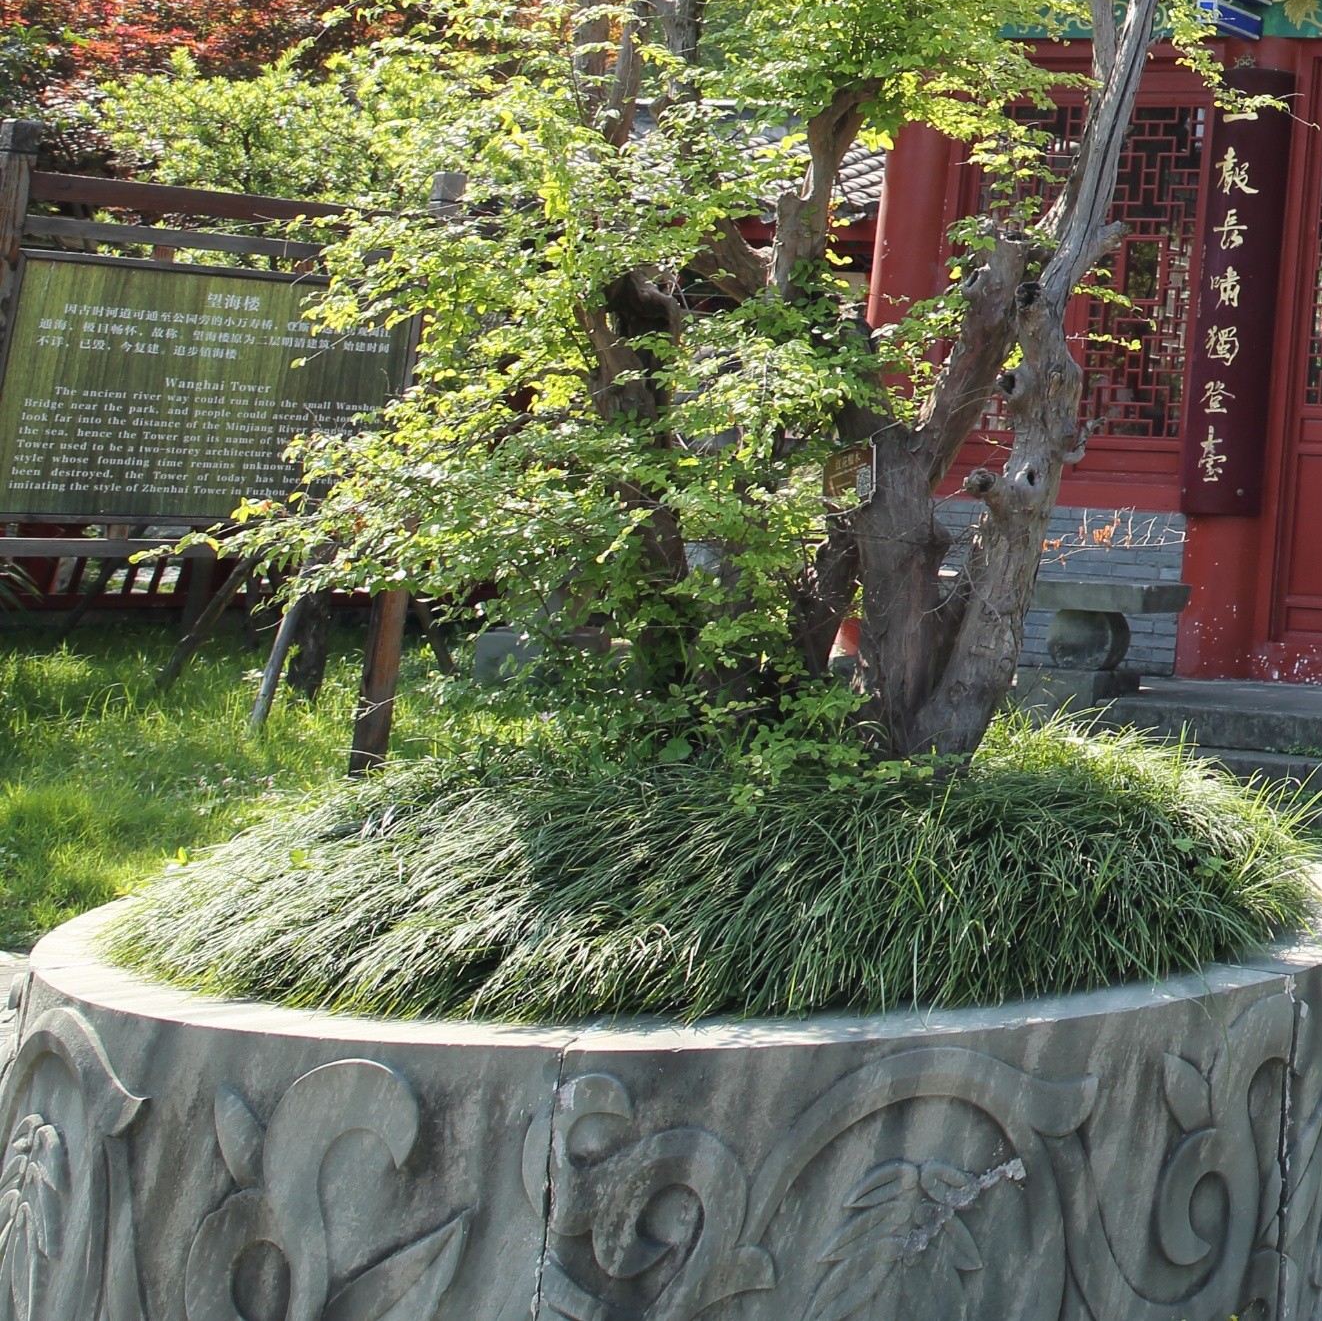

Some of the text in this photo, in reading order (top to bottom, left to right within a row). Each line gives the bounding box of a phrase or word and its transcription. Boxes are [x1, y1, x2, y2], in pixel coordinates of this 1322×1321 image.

[207, 292, 261, 312] 望海楼
[165, 377, 271, 393] Wanghai Tower
[55, 386, 77, 396] The
[82, 389, 127, 398] ancient
[133, 391, 162, 400] river
[167, 394, 189, 404] way
[194, 396, 225, 405] could
[230, 398, 249, 406] run
[254, 398, 276, 407] into
[280, 399, 298, 408] the
[303, 401, 331, 410] small
[24, 398, 64, 410] Bridge
[104, 403, 123, 412] the
[168, 407, 189, 416] and
[194, 409, 231, 418] people
[237, 411, 267, 419] could
[272, 413, 309, 421] ascend
[21, 412, 49, 421] look
[54, 413, 72, 423] far
[78, 415, 102, 424] into
[107, 417, 127, 426] the
[132, 418, 181, 428] distance
[186, 421, 198, 429] of
[202, 421, 220, 430] the
[225, 422, 274, 433] Minjiang
[278, 425, 308, 434] River
[19, 426, 39, 435] the
[76, 428, 113, 438] hence
[118, 430, 137, 439] the
[143, 431, 179, 441] Tower
[183, 434, 201, 443] got
[206, 434, 220, 443] its
[225, 436, 255, 444] name
[260, 436, 272, 445] of
[16, 439, 55, 449] Tower
[60, 442, 87, 451] used
[92, 443, 104, 451] to
[109, 443, 123, 452] be
[139, 445, 201, 457] two-storey
[205, 447, 273, 458] architecture
[14, 454, 44, 464] style
[52, 455, 89, 464] whose
[97, 456, 150, 467] founding
[157, 459, 183, 468] time
[191, 460, 235, 469] remains
[11, 467, 41, 476] been
[125, 470, 144, 479] the
[153, 471, 189, 480] Tower
[197, 472, 209, 481] of
[217, 473, 247, 484] today
[255, 474, 274, 483] has
[282, 475, 306, 484] bee
[8, 480, 65, 492] imitating
[69, 482, 90, 491] the
[93, 483, 122, 493] style
[125, 483, 139, 492] of
[142, 484, 189, 494] Zhenhai
[193, 485, 227, 495] Tower
[231, 486, 241, 495] in
